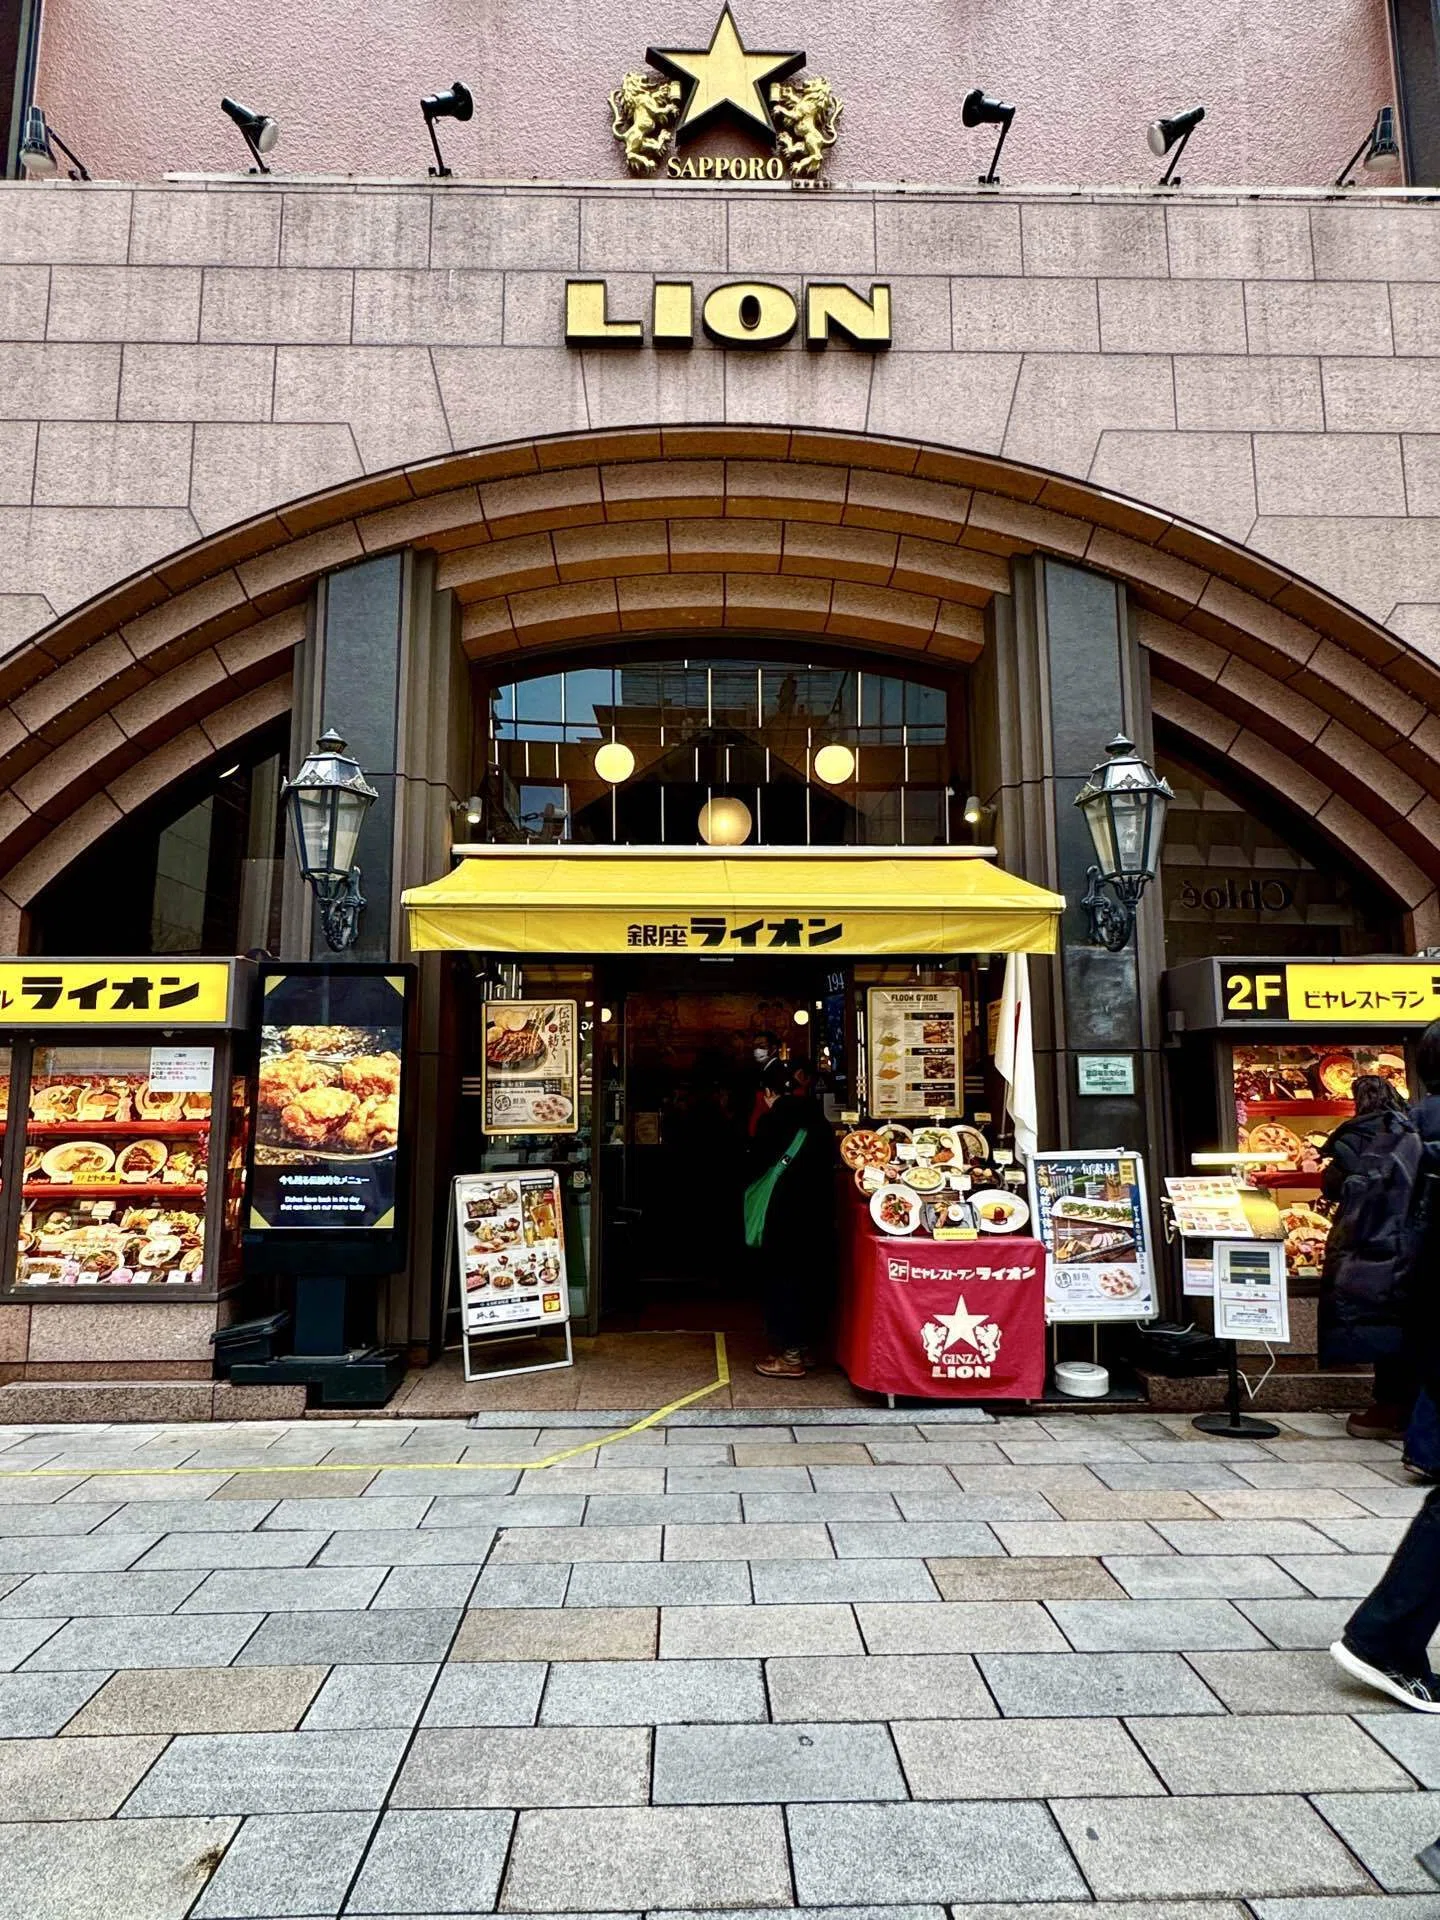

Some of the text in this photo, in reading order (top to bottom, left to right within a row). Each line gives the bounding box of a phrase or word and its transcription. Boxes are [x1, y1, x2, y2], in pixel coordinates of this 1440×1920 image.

[667, 156, 783, 179] SAPPORO
[565, 279, 892, 349] LION
[627, 917, 843, 947] 銀座ライオン
[1226, 974, 1282, 1011] 2F
[1304, 990, 1424, 1009] ビヤレストラン
[889, 1262, 908, 1278] 2F
[976, 1266, 1037, 1281] ライオン
[942, 1353, 982, 1365] GINZA
[931, 1365, 991, 1379] LION
